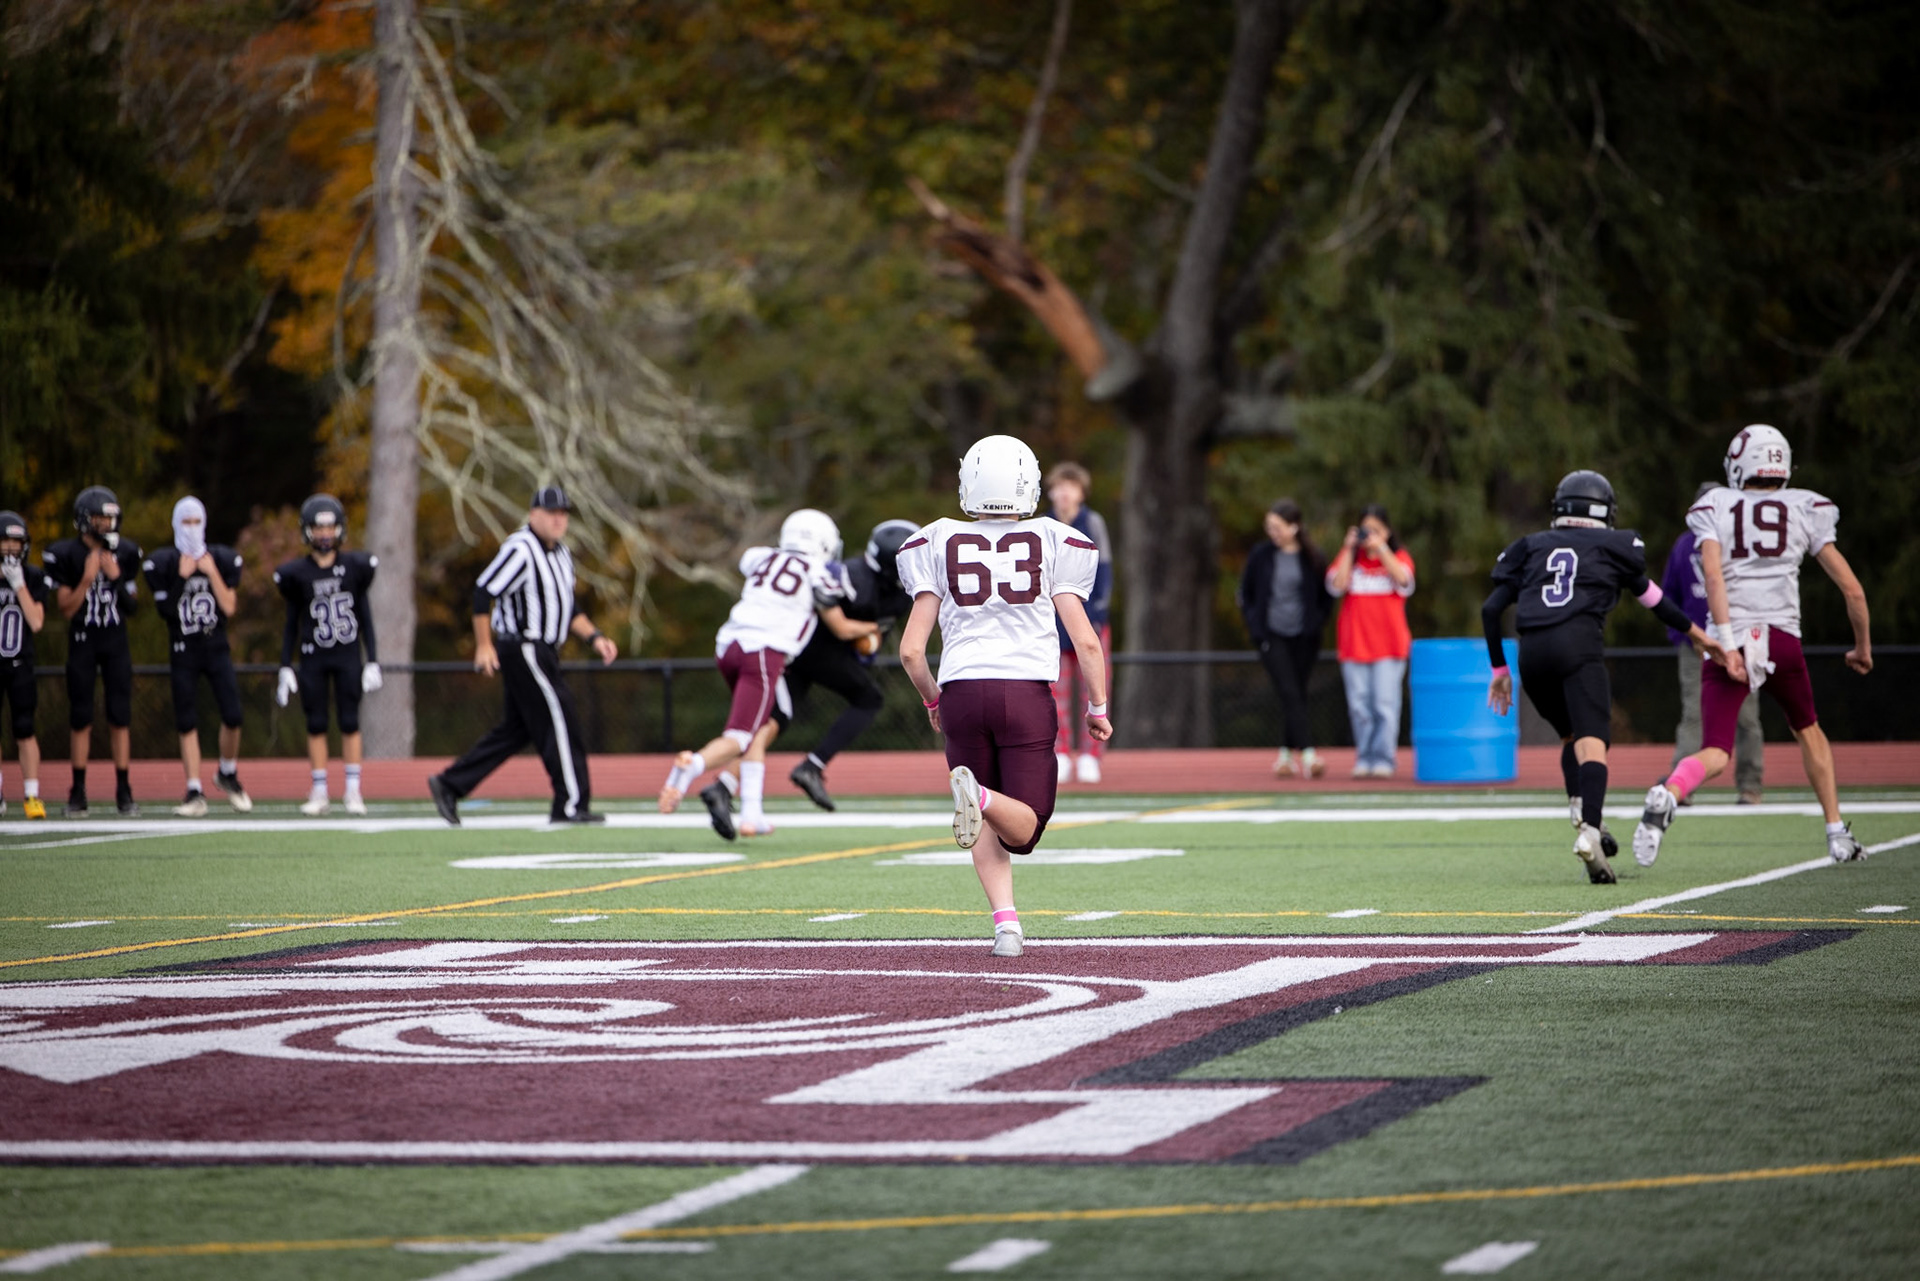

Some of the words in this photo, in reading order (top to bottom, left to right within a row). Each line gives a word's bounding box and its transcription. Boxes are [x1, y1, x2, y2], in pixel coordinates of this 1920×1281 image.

[983, 503, 1014, 511] XENITH
[1729, 499, 1788, 559] 19
[751, 552, 810, 596] 46
[946, 531, 1042, 607] 63
[1541, 547, 1579, 608] 3
[0, 604, 23, 658] 0
[309, 591, 359, 649] 35
